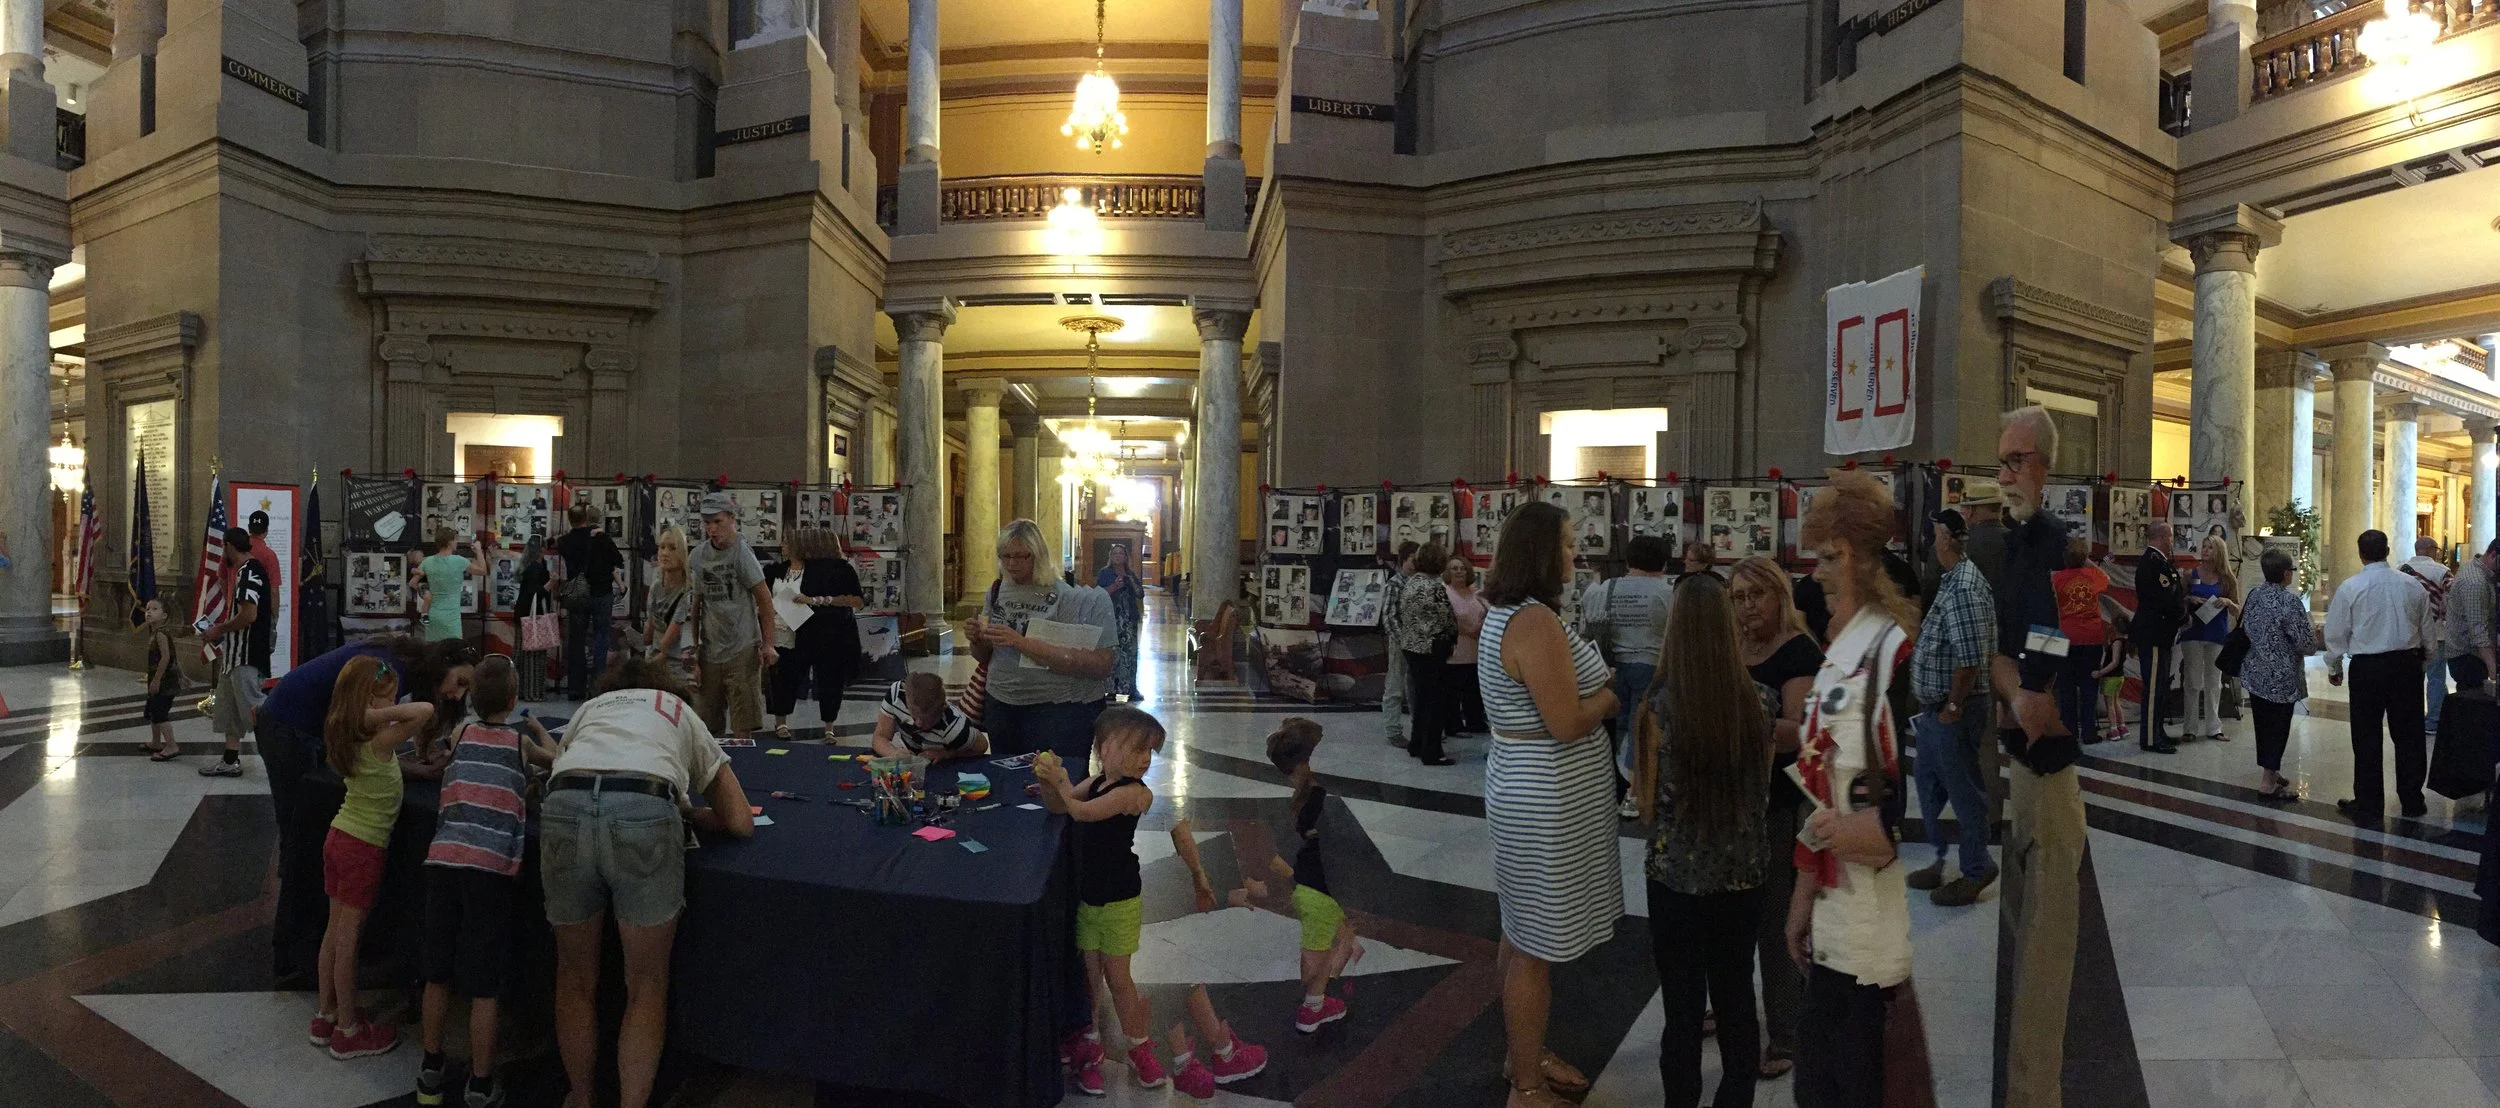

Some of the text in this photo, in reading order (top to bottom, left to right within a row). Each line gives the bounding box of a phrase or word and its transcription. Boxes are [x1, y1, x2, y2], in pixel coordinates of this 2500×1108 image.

[1886, 0, 1929, 28] HISTO
[228, 61, 302, 104] COMMERCE
[1308, 98, 1376, 116] LIBERTY
[732, 119, 793, 141] JUSTICE
[364, 505, 383, 517] WAR
